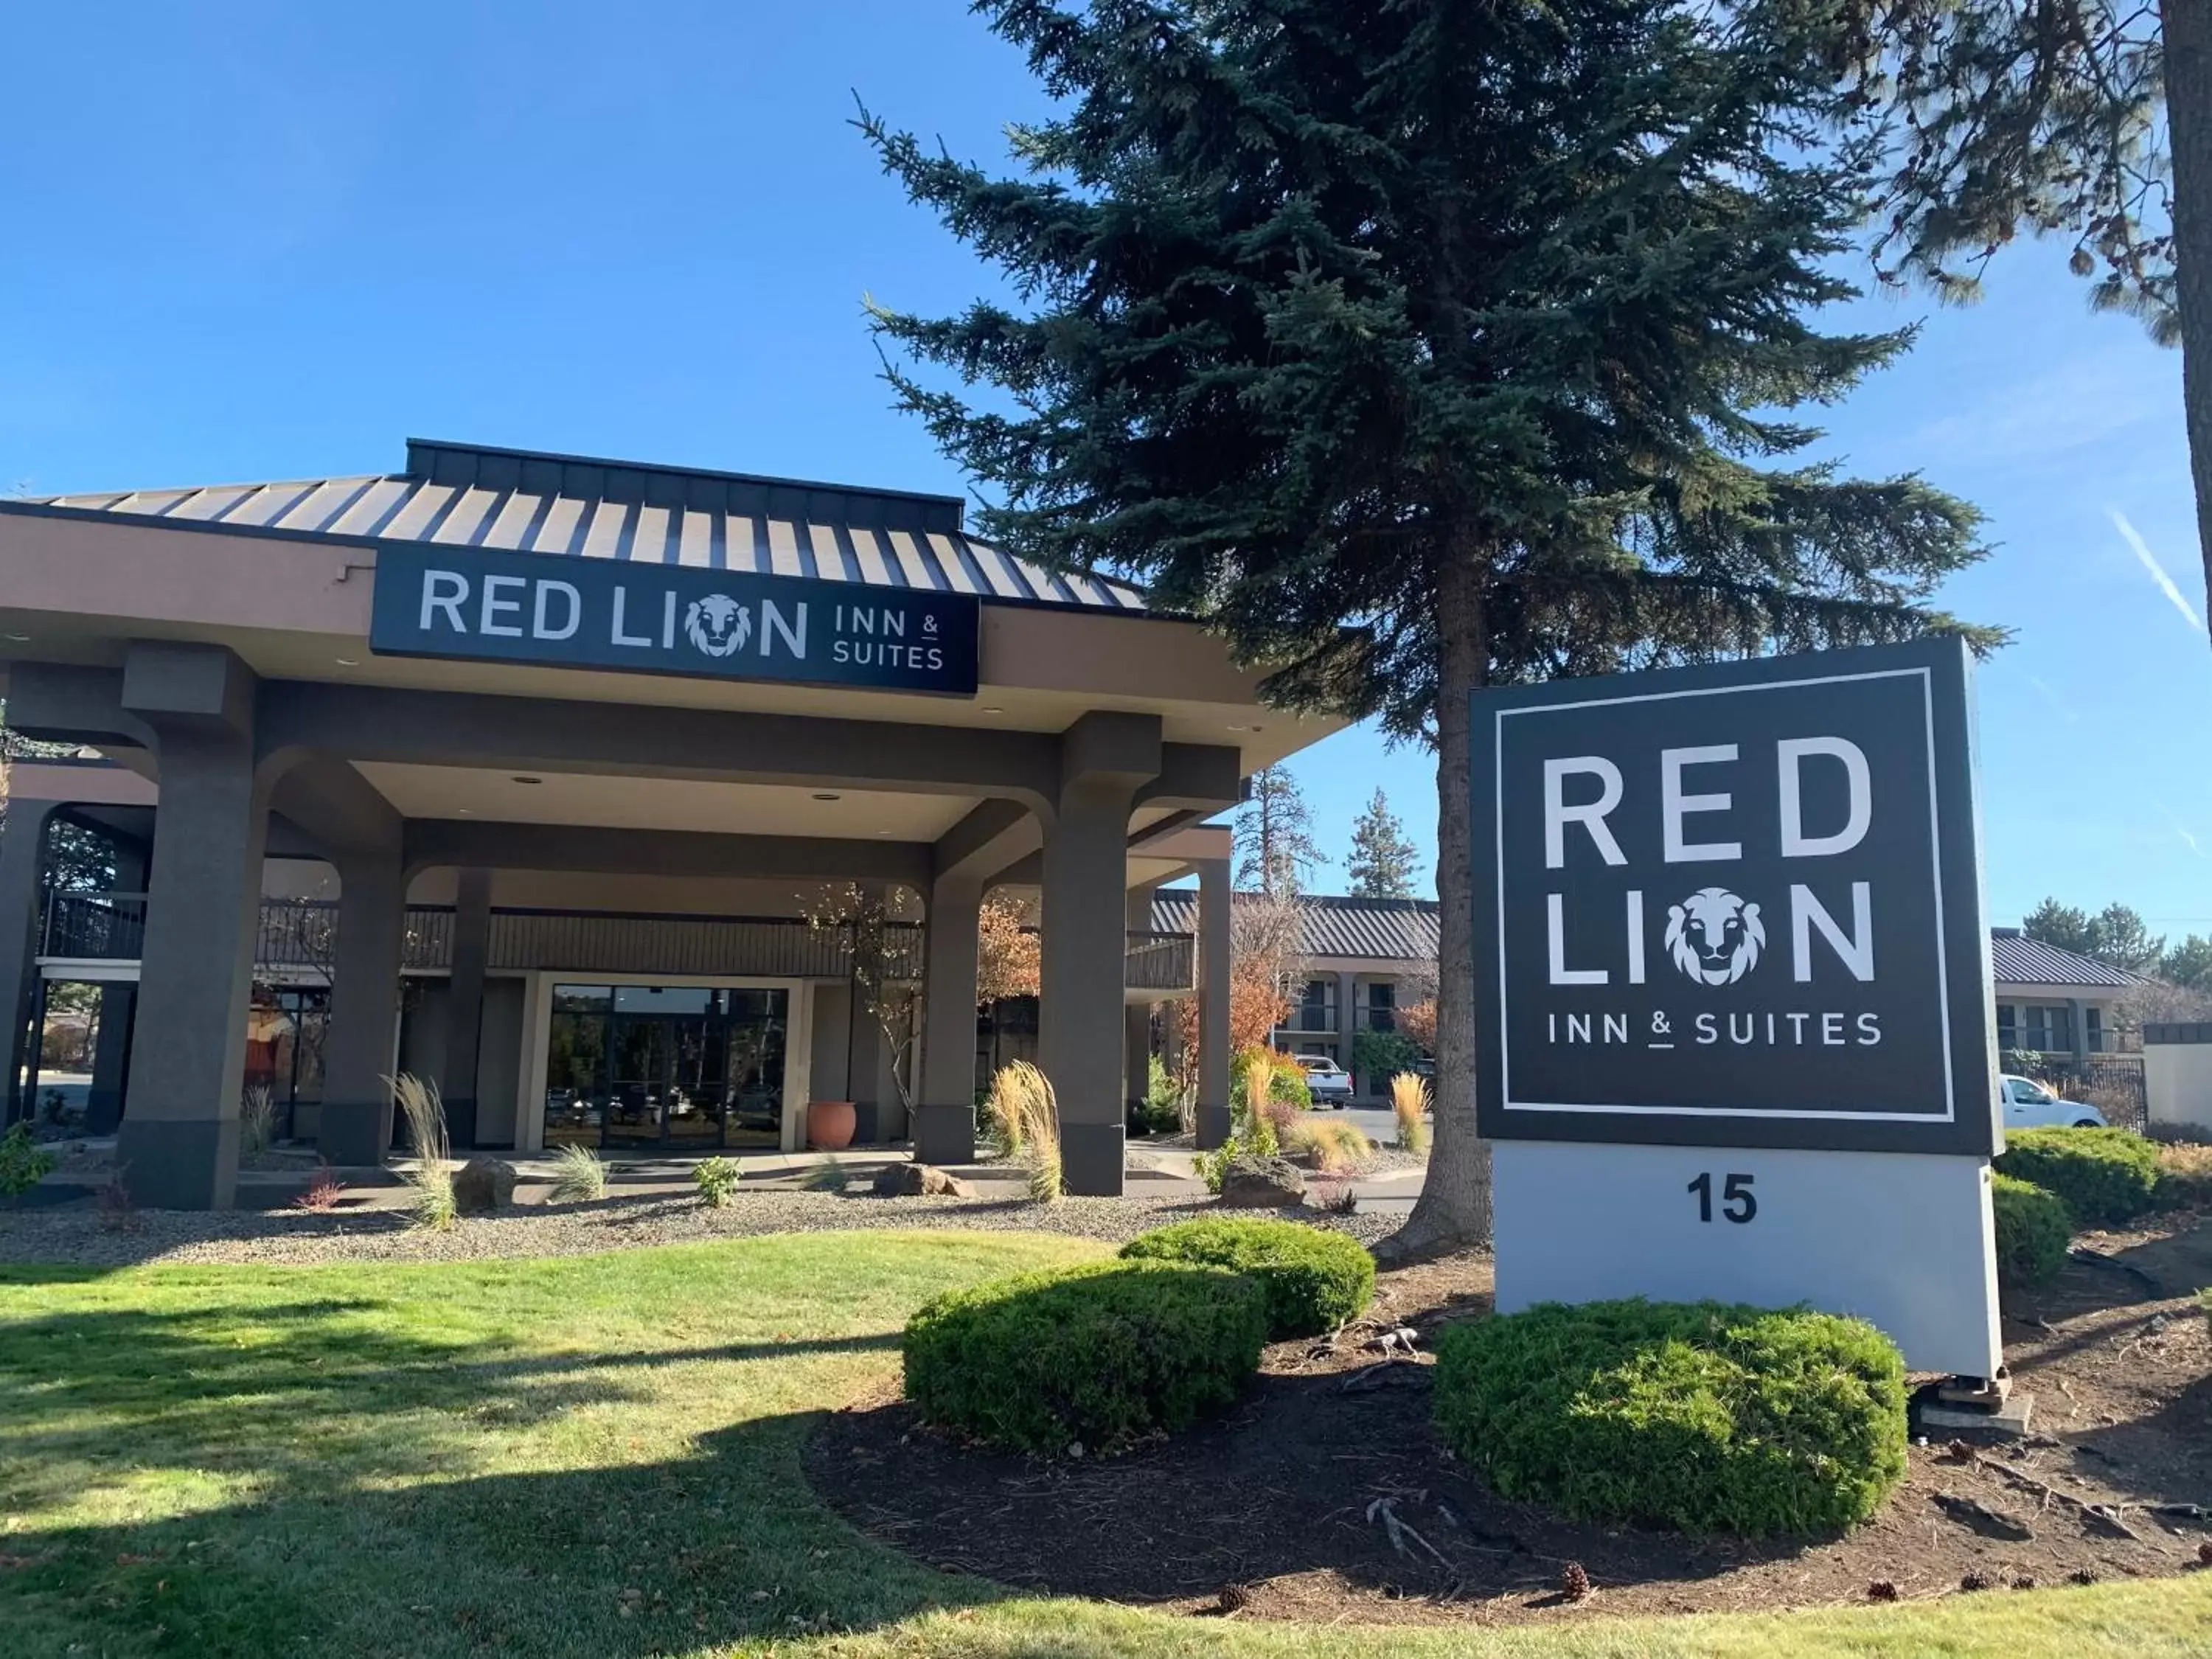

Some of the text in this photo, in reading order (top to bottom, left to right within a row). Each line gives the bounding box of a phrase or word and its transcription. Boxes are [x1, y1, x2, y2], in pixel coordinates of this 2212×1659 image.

[419, 570, 807, 658] RED LION
[835, 605, 939, 637] INN &
[832, 641, 943, 670] SUITES
[1544, 736, 1872, 869] RED
[1548, 881, 1876, 987] LION
[1549, 1010, 1881, 1046] INN & SUITES
[1687, 1172, 1757, 1224] 15
